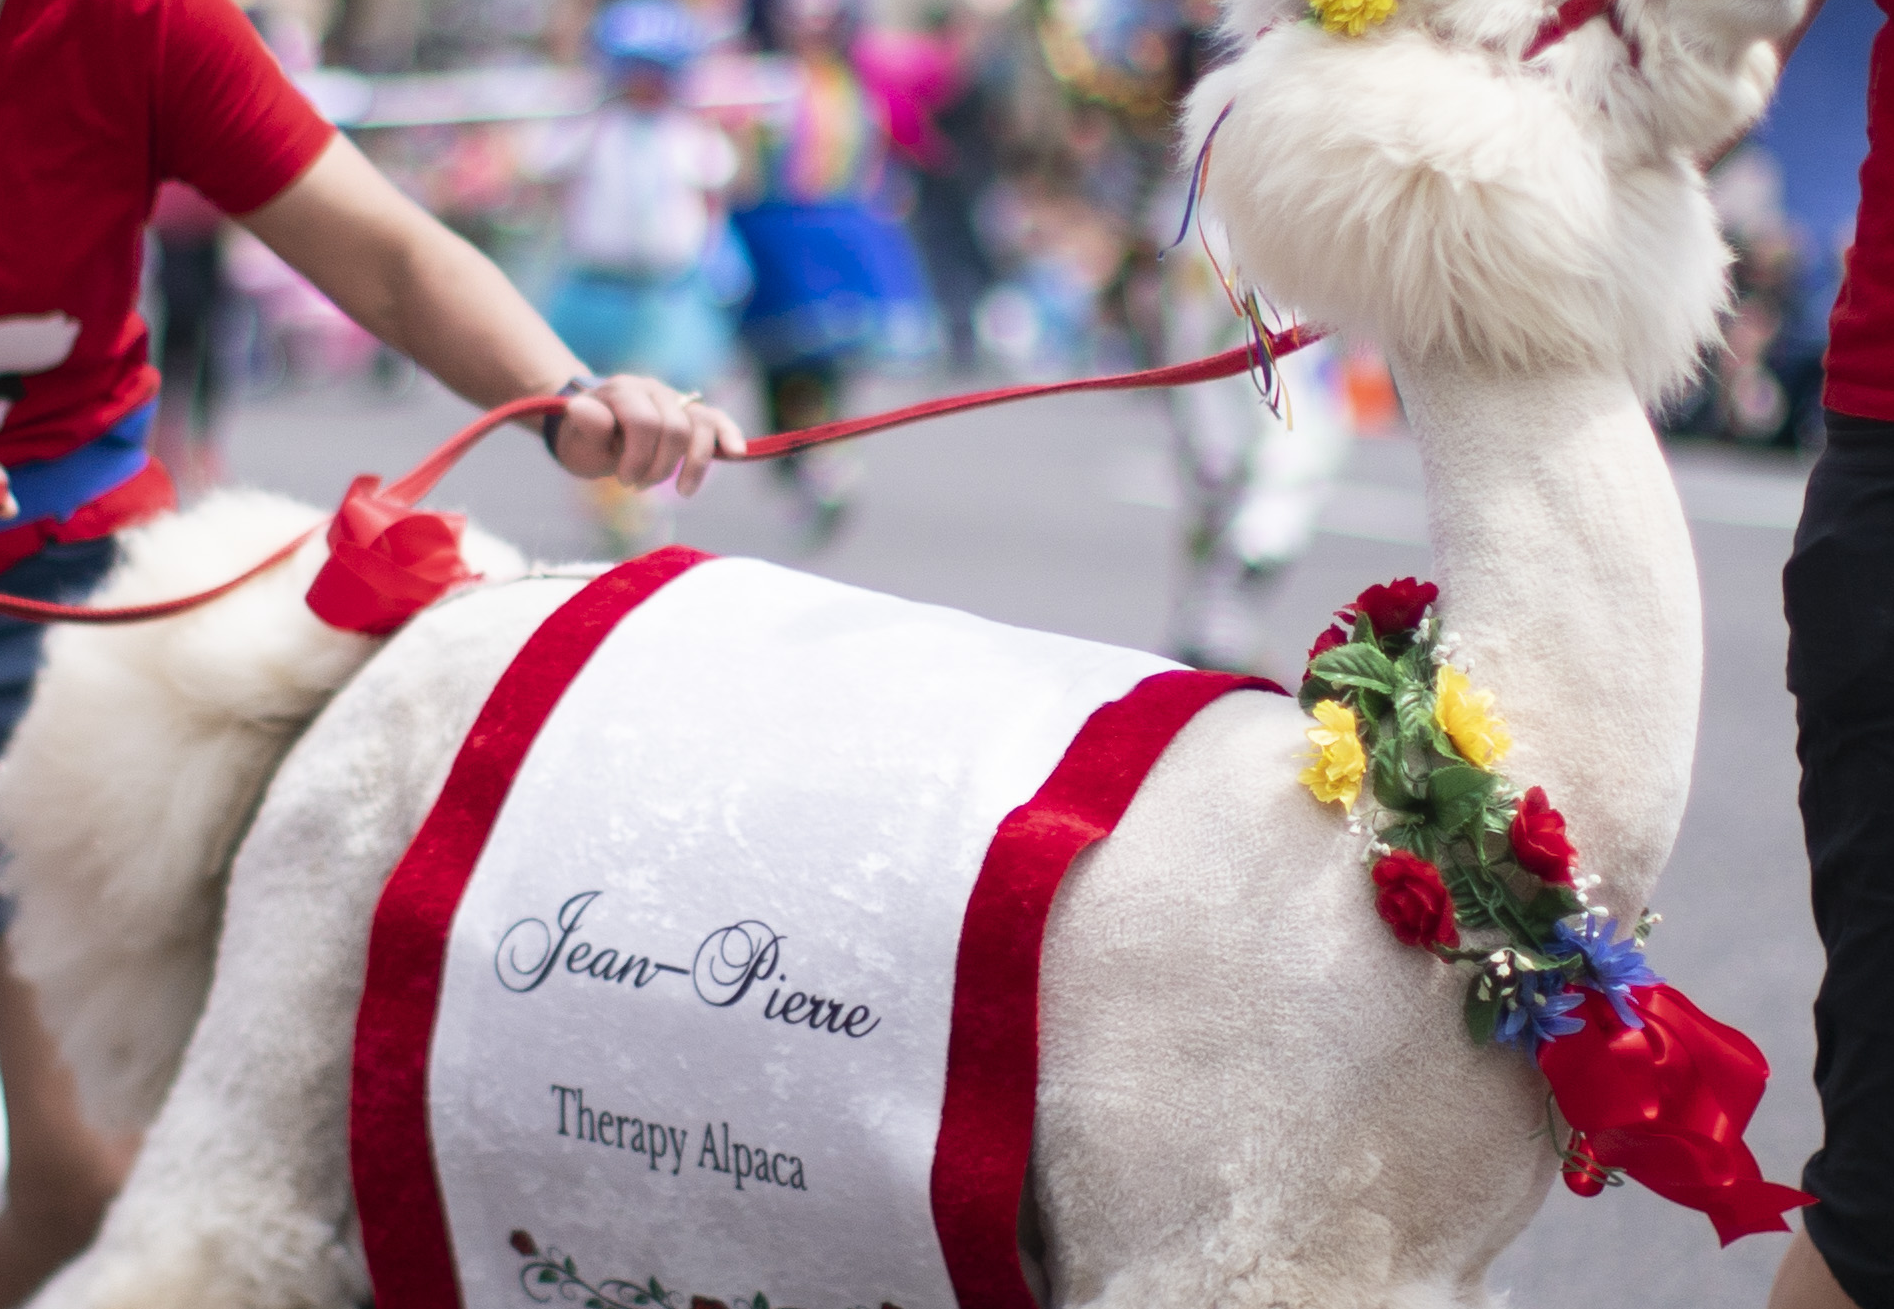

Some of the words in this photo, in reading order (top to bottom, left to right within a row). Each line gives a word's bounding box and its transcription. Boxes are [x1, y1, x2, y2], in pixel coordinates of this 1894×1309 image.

[494, 890, 882, 1039] Jean-Pierre
[549, 1083, 689, 1176] Therapy
[696, 1121, 809, 1191] Alpaca
